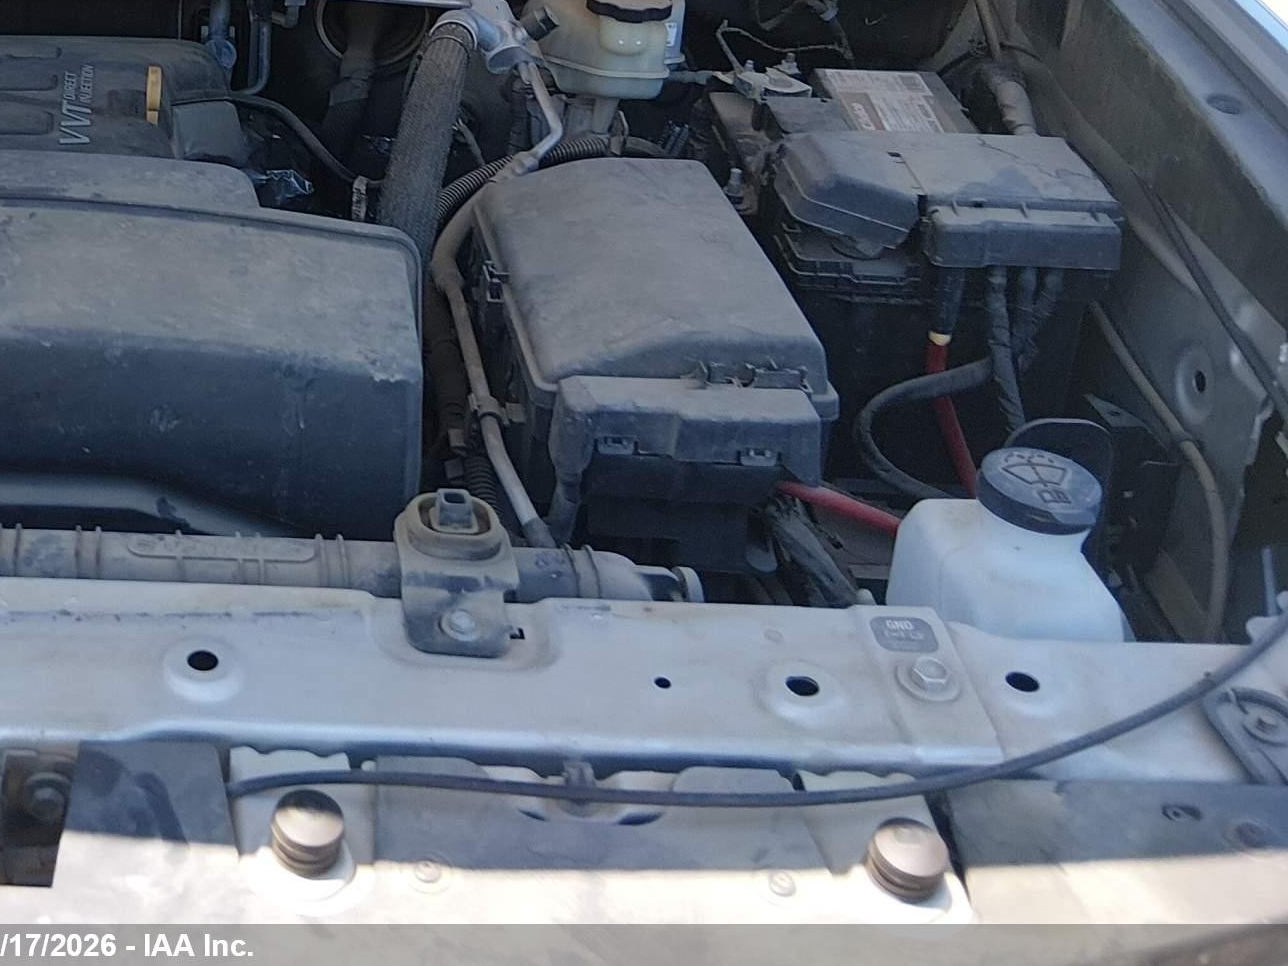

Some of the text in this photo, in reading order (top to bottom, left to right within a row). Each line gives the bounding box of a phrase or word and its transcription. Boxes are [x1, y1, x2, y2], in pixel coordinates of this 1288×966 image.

[63, 71, 78, 101] DIRECT
[79, 63, 94, 104] INJECTION
[59, 100, 92, 144] VVT
[886, 619, 913, 630] GND
